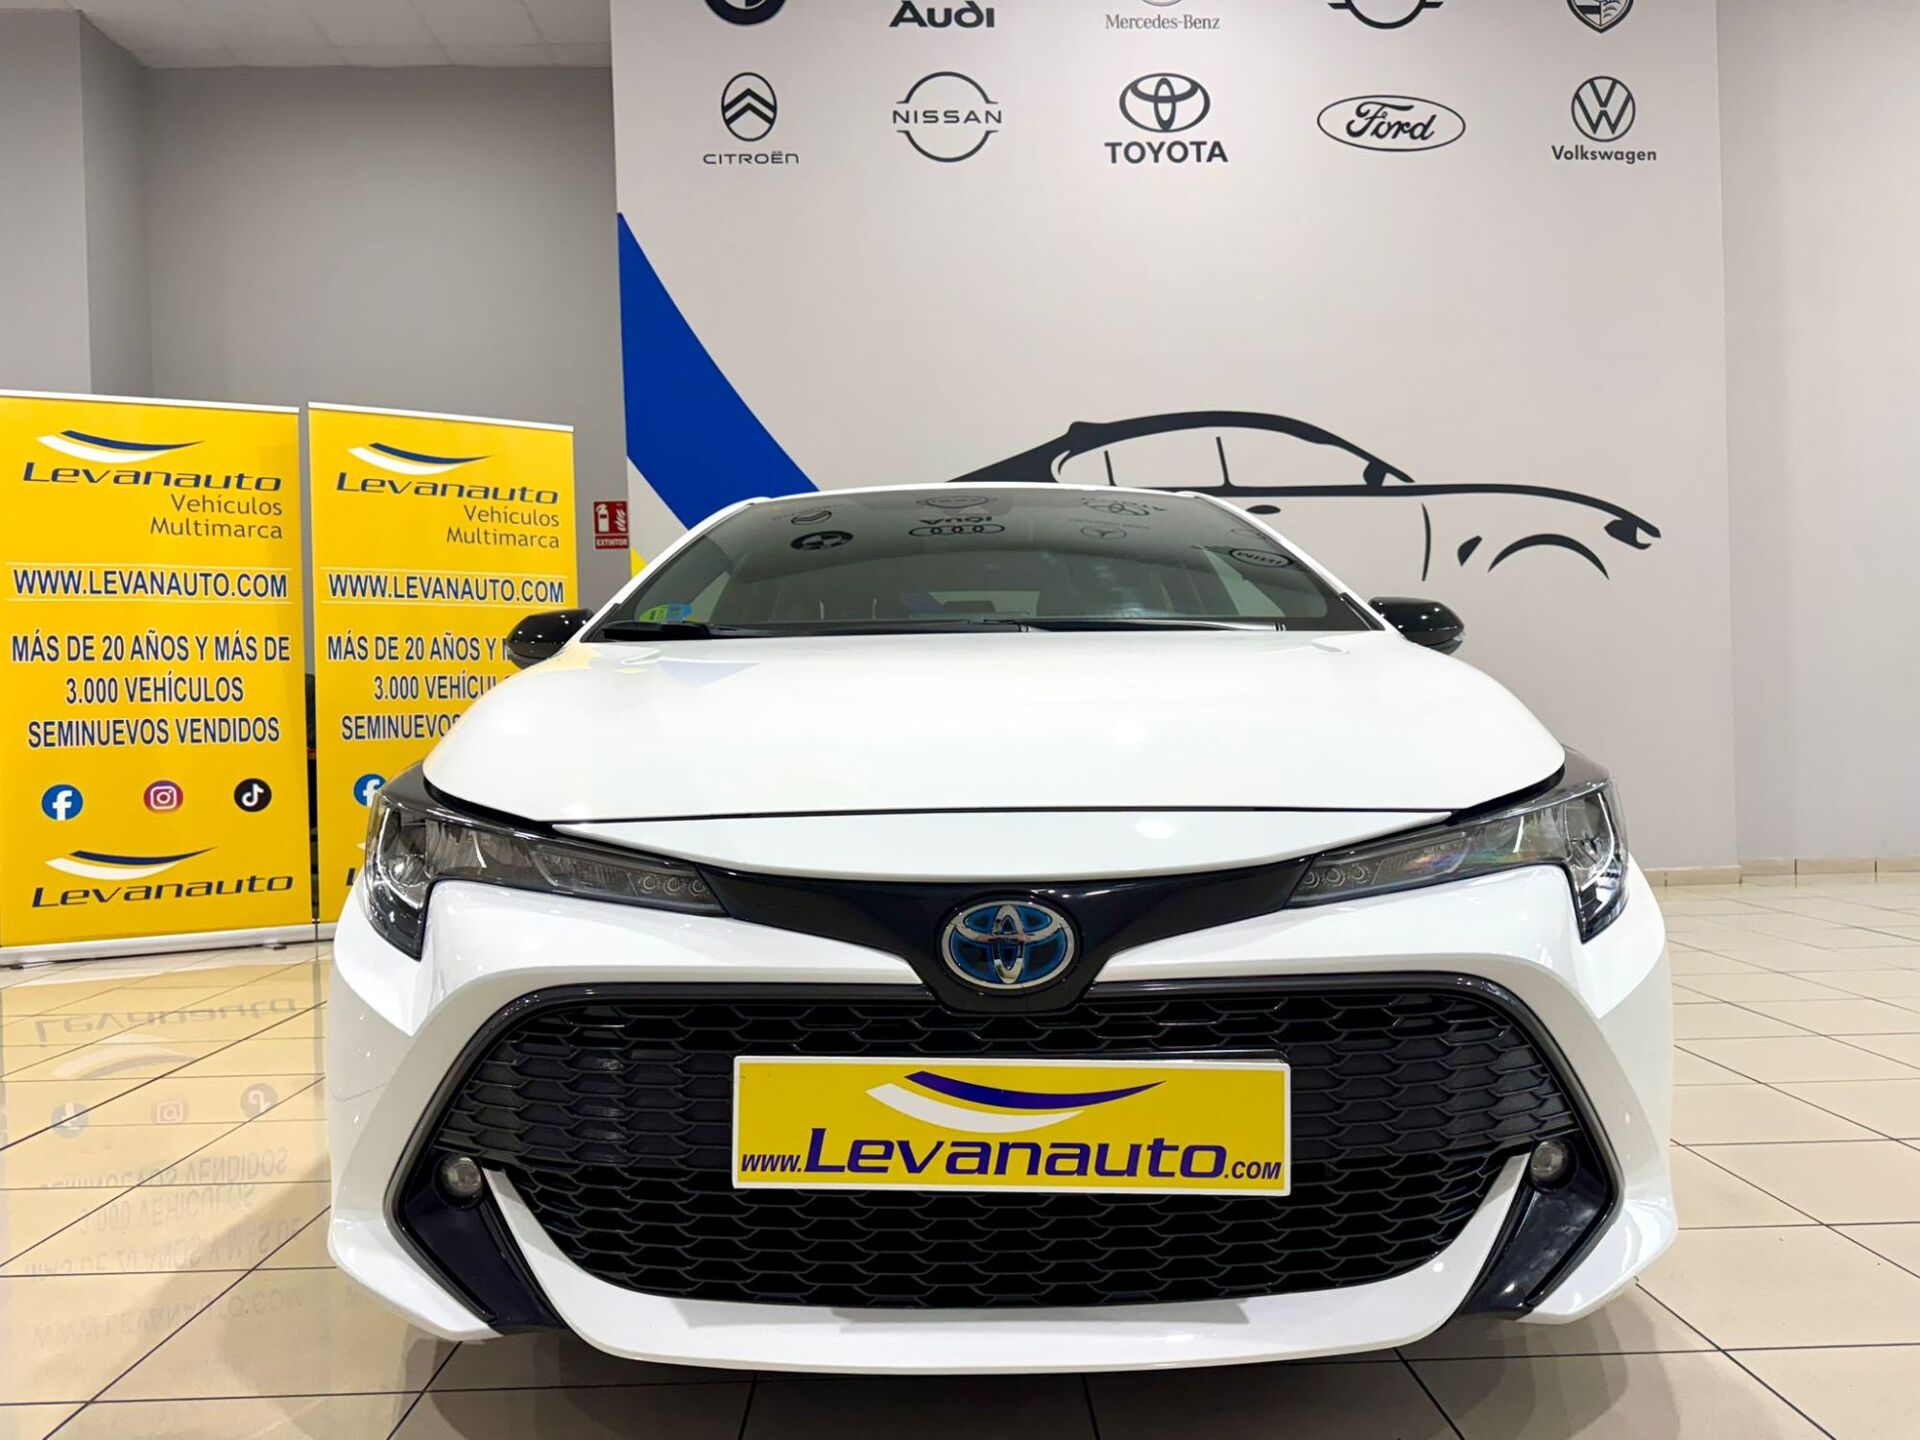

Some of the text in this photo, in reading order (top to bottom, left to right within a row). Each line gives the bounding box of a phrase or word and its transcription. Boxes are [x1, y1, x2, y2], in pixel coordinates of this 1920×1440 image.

[889, 0, 995, 28] Audi
[1105, 14, 1221, 30] Mercedes-Benz
[892, 109, 1002, 124] NISSAN
[1346, 101, 1437, 141] Ford
[1104, 140, 1229, 164] TOYOTA
[1551, 144, 1657, 165] Volkswagen
[23, 462, 282, 491] Levanauto
[336, 472, 559, 505] Levanauto
[170, 494, 283, 516] Vehículos
[464, 505, 560, 528] Vehículos
[150, 517, 283, 539] Multimarca
[446, 527, 560, 549] Multimarca
[13, 569, 288, 598] WWW.LEVANAUTO.COM
[328, 574, 565, 603] WWW.LEVANAUTO.COM
[12, 629, 291, 662] MÁS DE 20 AÑOS Y MÁS DE
[327, 630, 369, 661] MÁS
[374, 635, 400, 661] DE
[405, 636, 425, 661] 20
[429, 631, 481, 661] AÑOS
[485, 637, 497, 661] Y
[65, 671, 244, 704] 3.000 VEHÍCULOS
[374, 675, 419, 700] 3.000
[28, 716, 280, 748] SEMINUEVOS VENDIDOS
[32, 874, 294, 908] Levanauto
